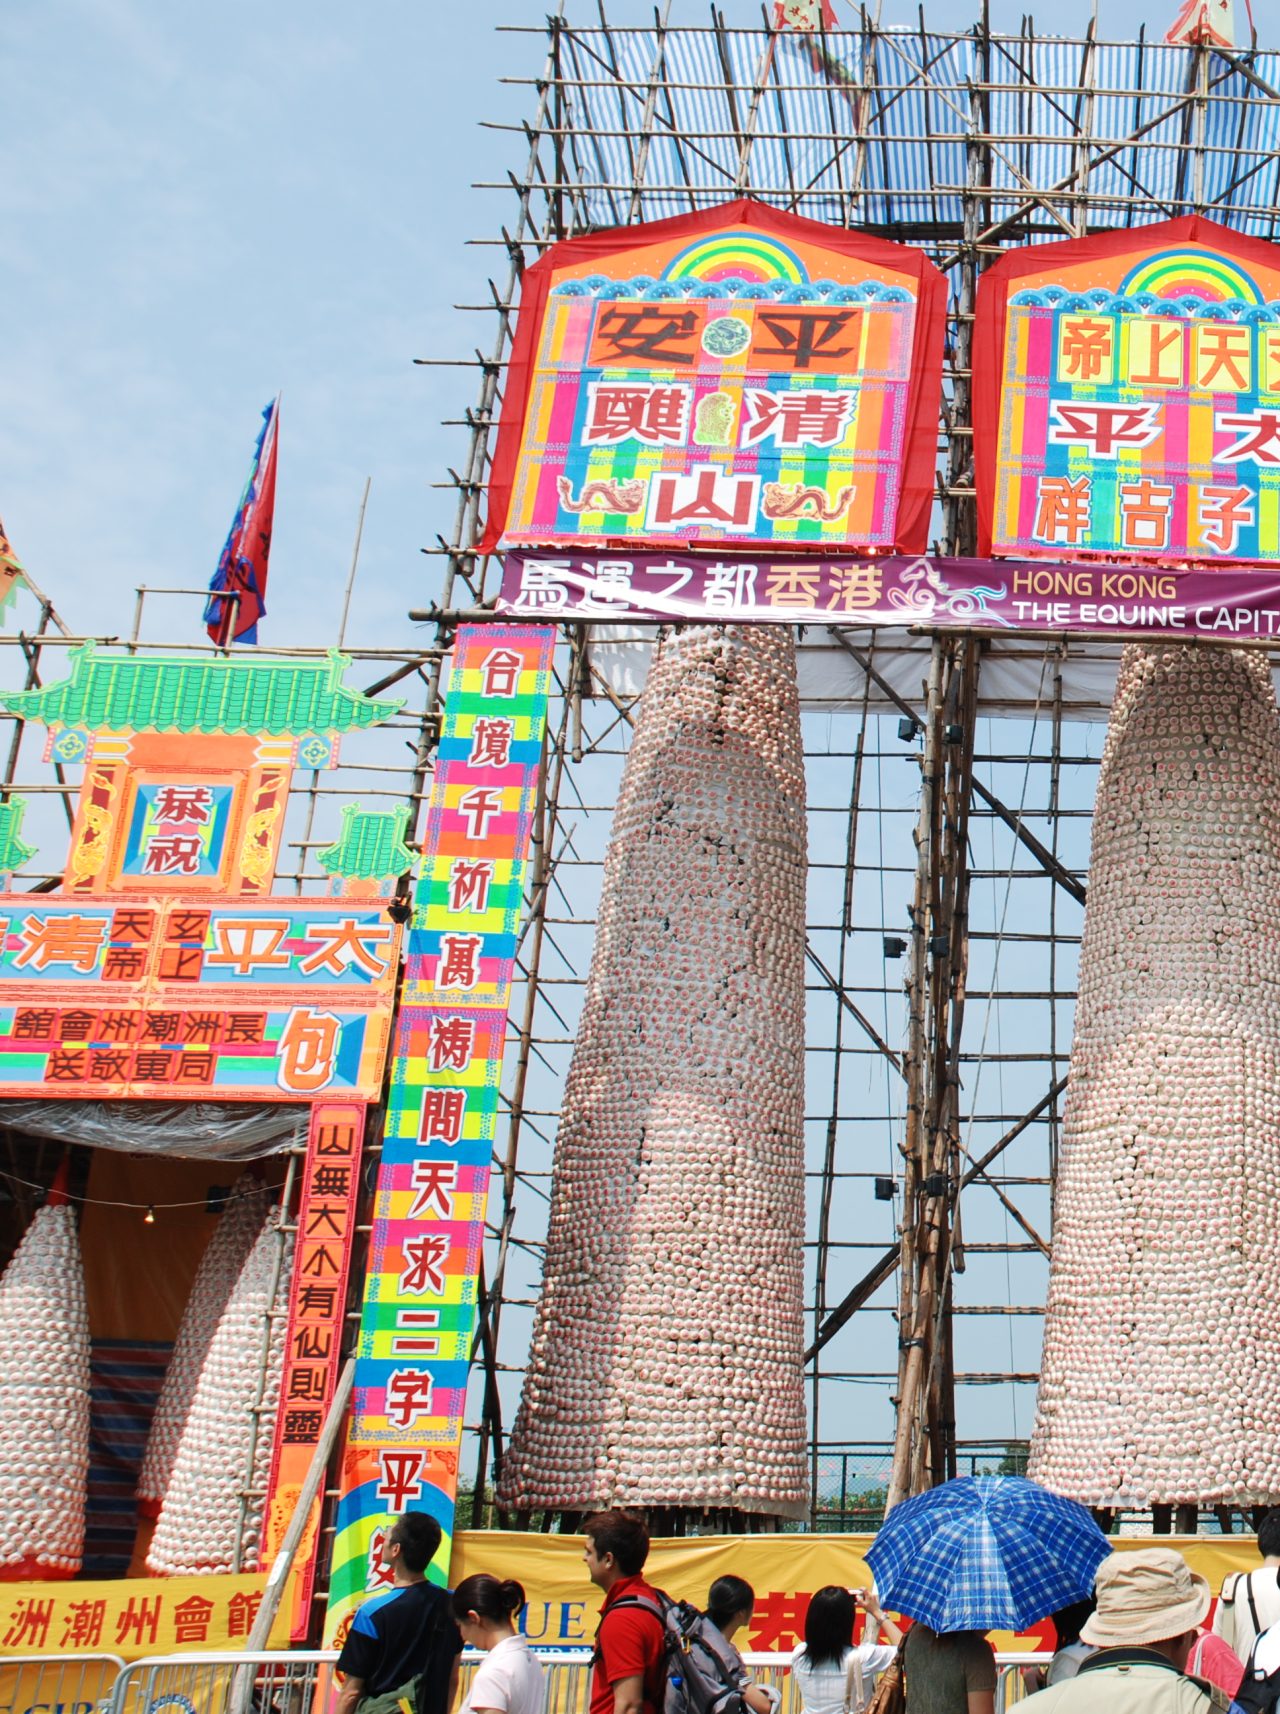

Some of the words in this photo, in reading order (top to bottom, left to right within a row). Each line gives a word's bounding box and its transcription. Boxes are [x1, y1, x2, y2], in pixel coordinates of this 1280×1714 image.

[650, 467, 758, 528] 山
[1013, 570, 1093, 596] HONG
[1102, 573, 1177, 599] KONG
[1012, 601, 1071, 624] THE
[1079, 604, 1186, 629] EQUINE
[145, 786, 211, 873] 恭祝
